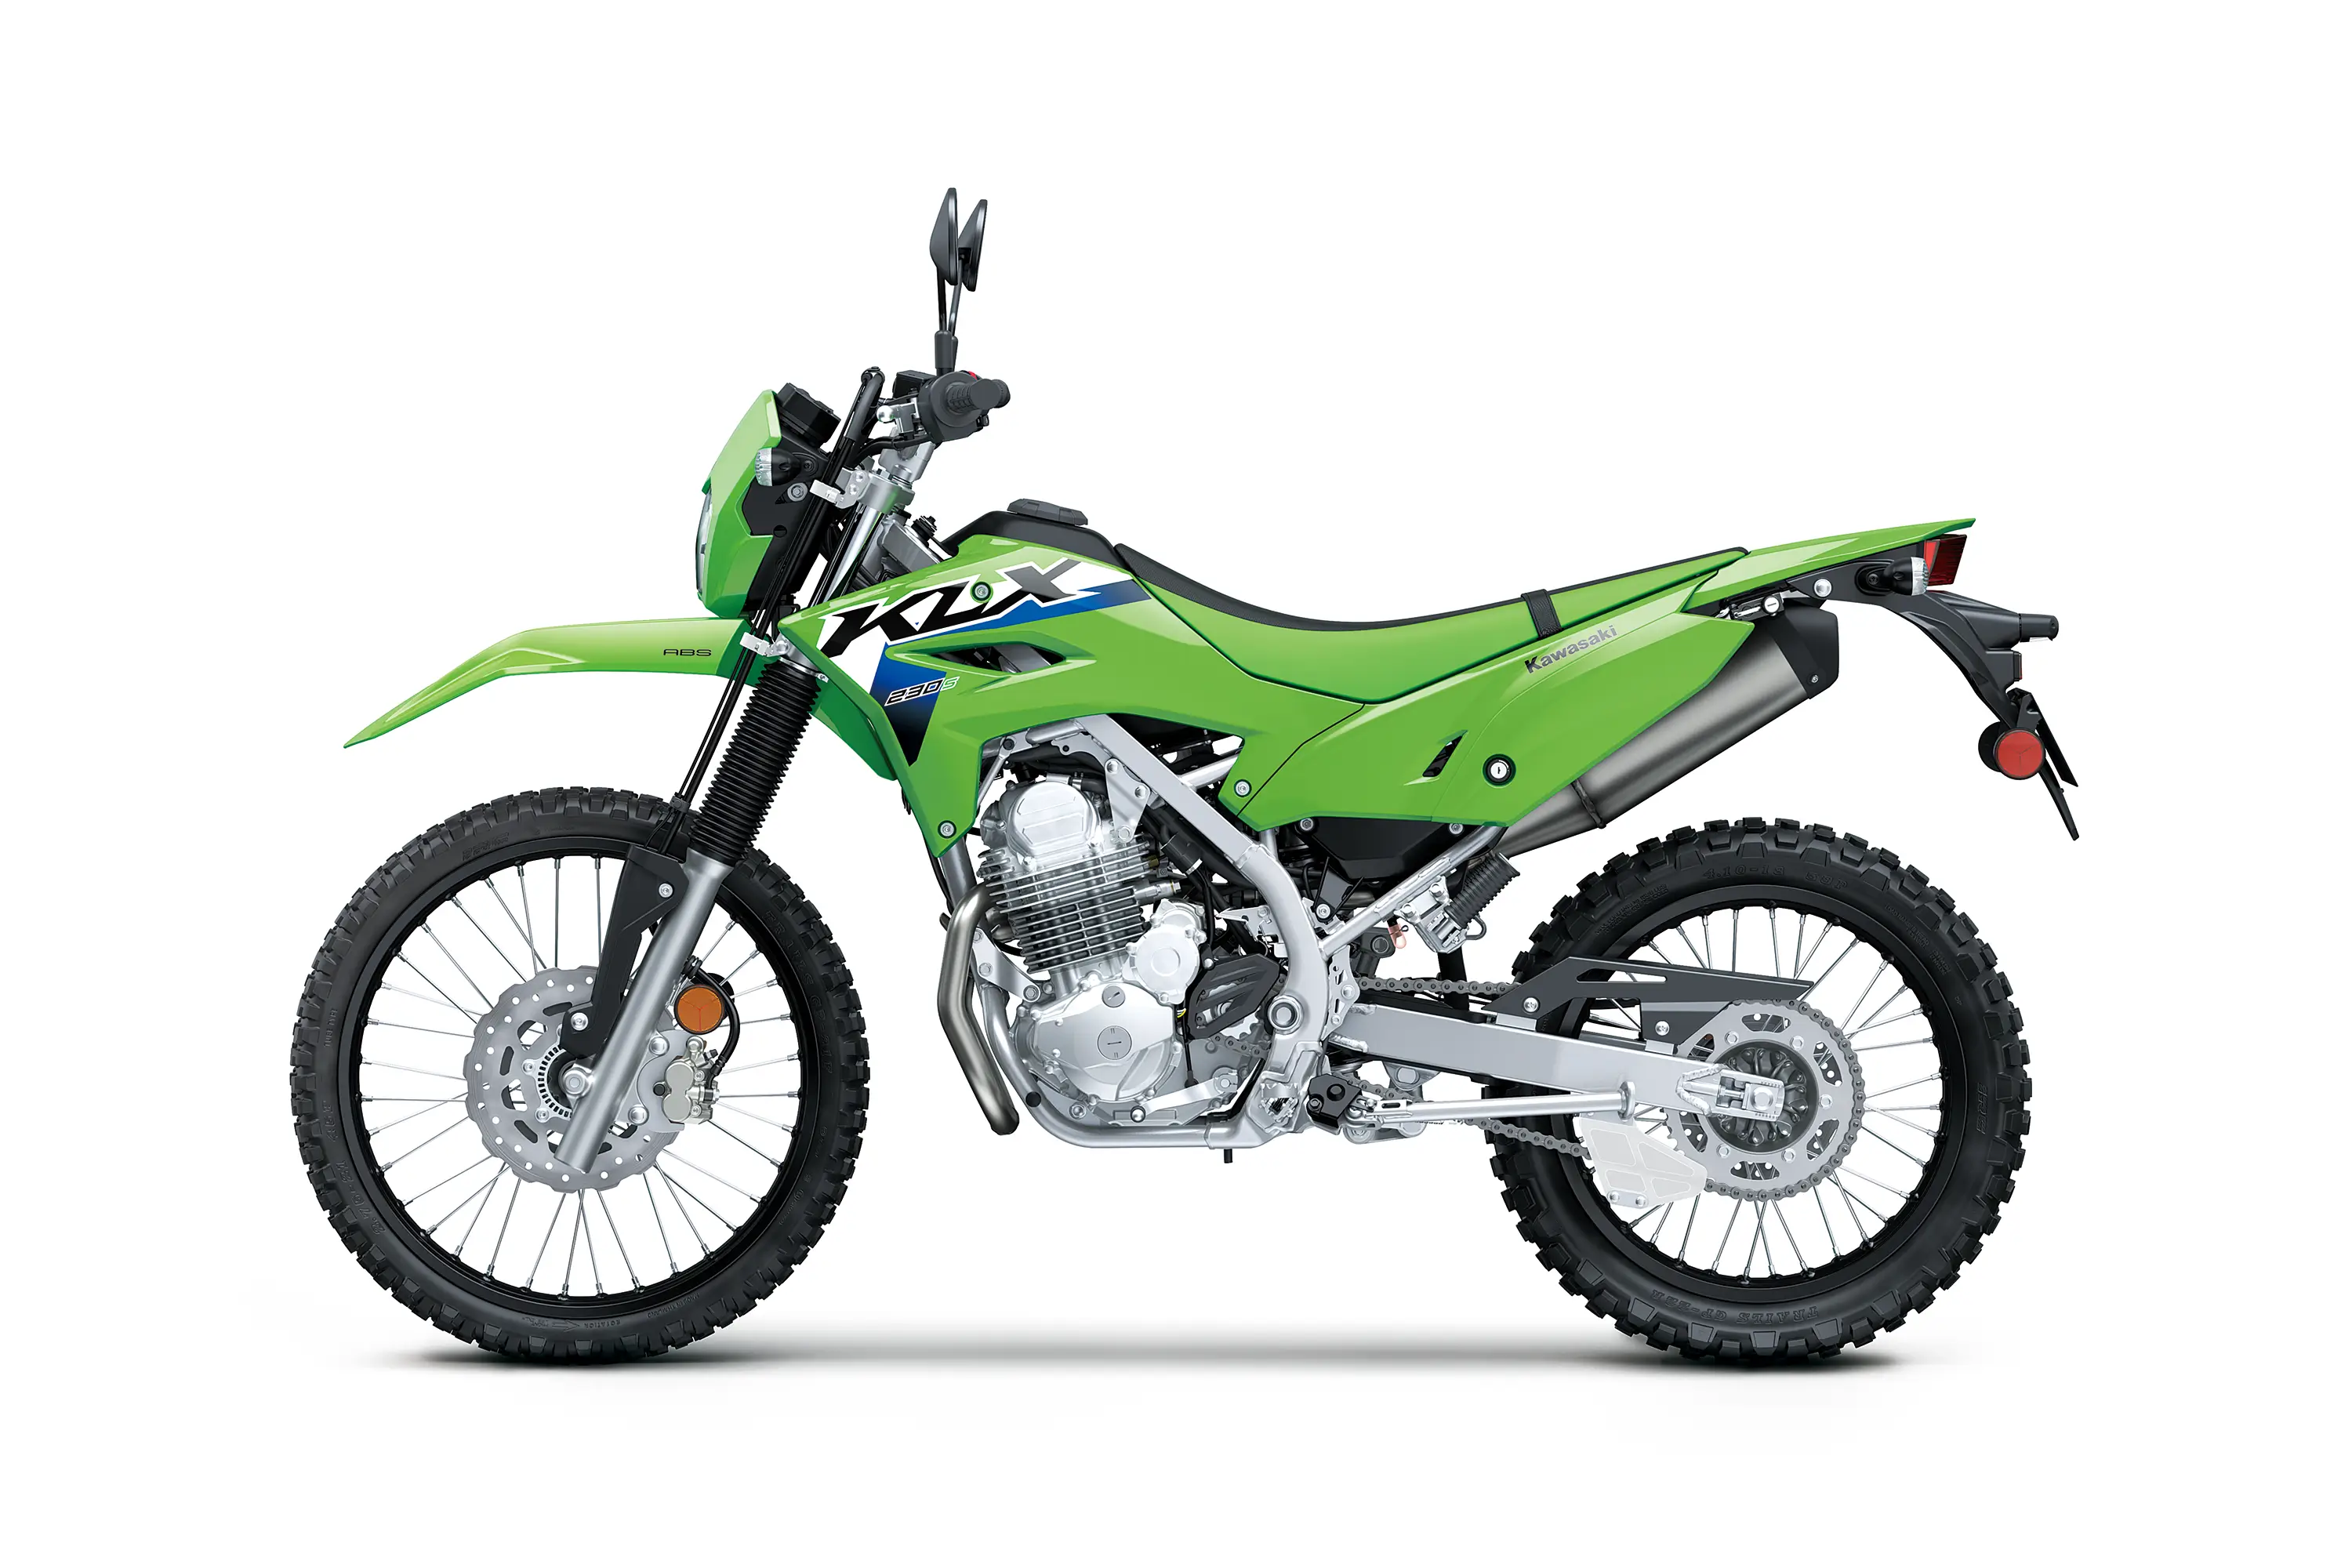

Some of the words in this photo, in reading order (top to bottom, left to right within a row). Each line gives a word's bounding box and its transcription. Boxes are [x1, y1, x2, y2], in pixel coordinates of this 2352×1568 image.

[822, 557, 1082, 658] KLX
[1524, 625, 1617, 673] Kawasaki
[884, 677, 960, 706] 230S
[1650, 1288, 1727, 1322] GP-22R
[1736, 1305, 1820, 1324] TRAILS
